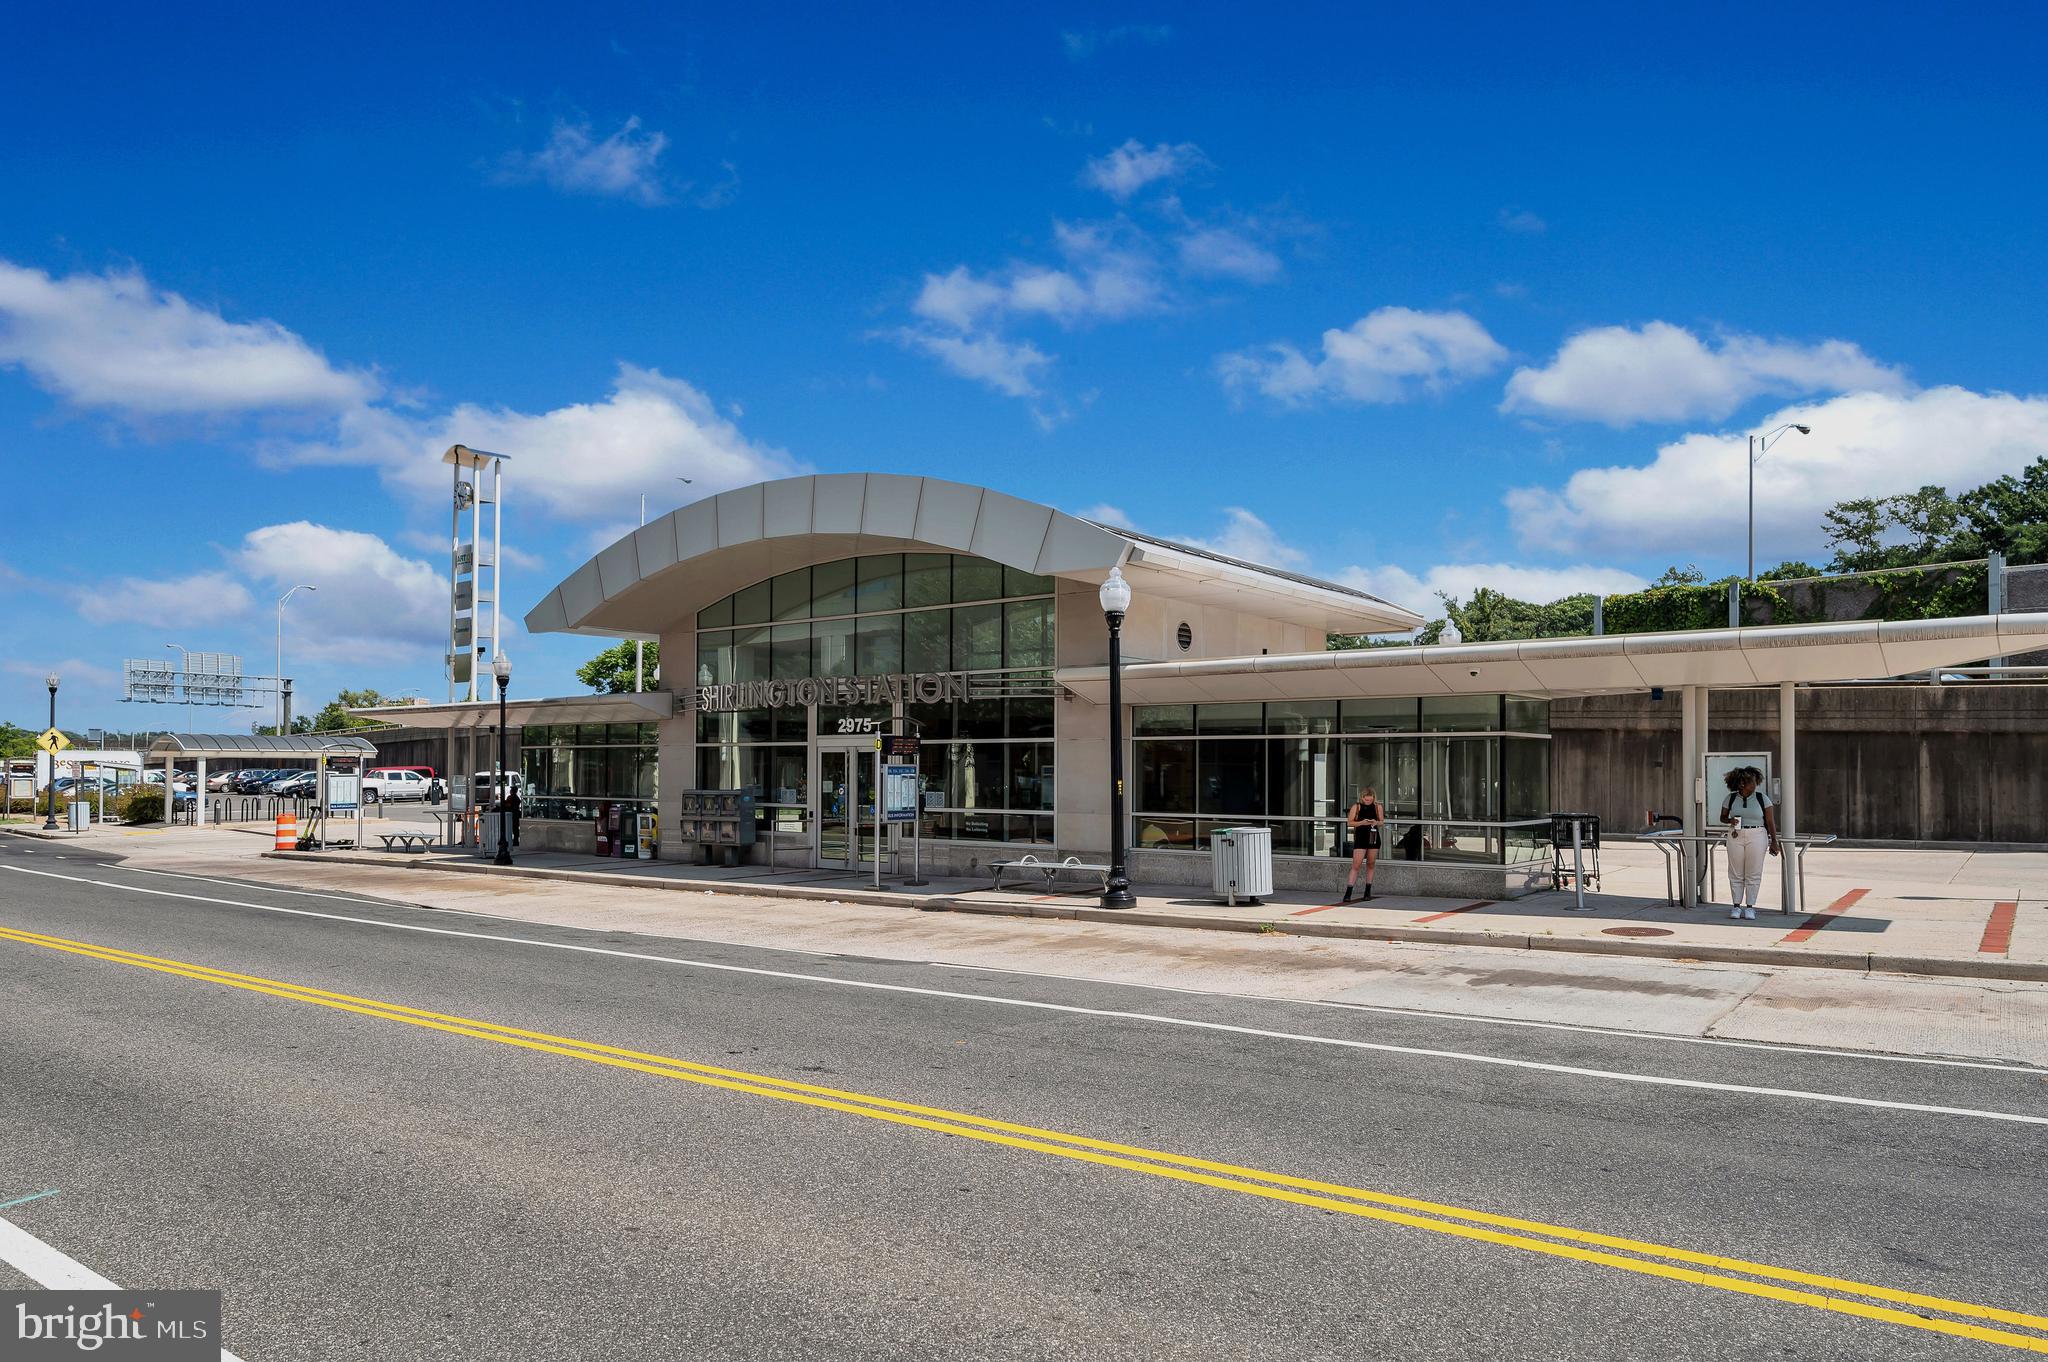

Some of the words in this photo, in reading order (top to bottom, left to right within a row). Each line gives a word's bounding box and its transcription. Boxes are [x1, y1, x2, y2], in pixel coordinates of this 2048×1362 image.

[701, 676, 839, 712] SHIRLINGTON
[846, 671, 970, 705] STATION
[837, 717, 872, 733] 2975
